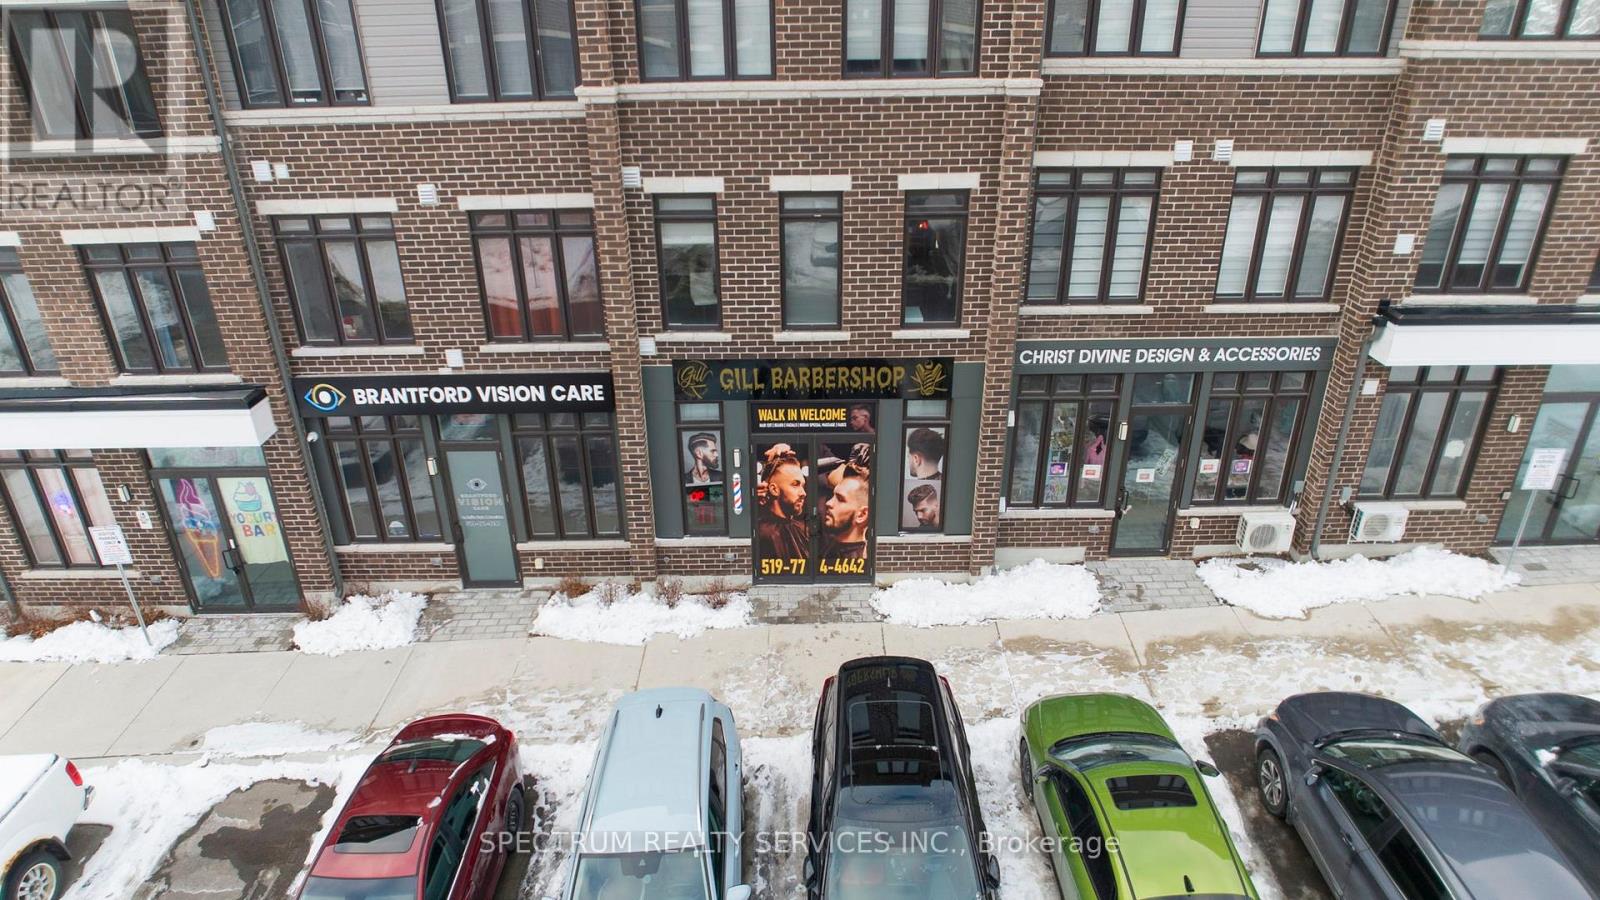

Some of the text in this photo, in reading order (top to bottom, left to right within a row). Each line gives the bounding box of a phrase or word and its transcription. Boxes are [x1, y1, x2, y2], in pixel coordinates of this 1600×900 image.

[1019, 346, 1321, 364] CHRIST DIVINE DESIGN & ACCESSORIES
[720, 366, 905, 391] GILL BARBERSHOP
[352, 384, 604, 405] BRANTFORD VISION CARE
[758, 408, 846, 421] WALK IN WELCOME
[242, 523, 276, 537] BAR
